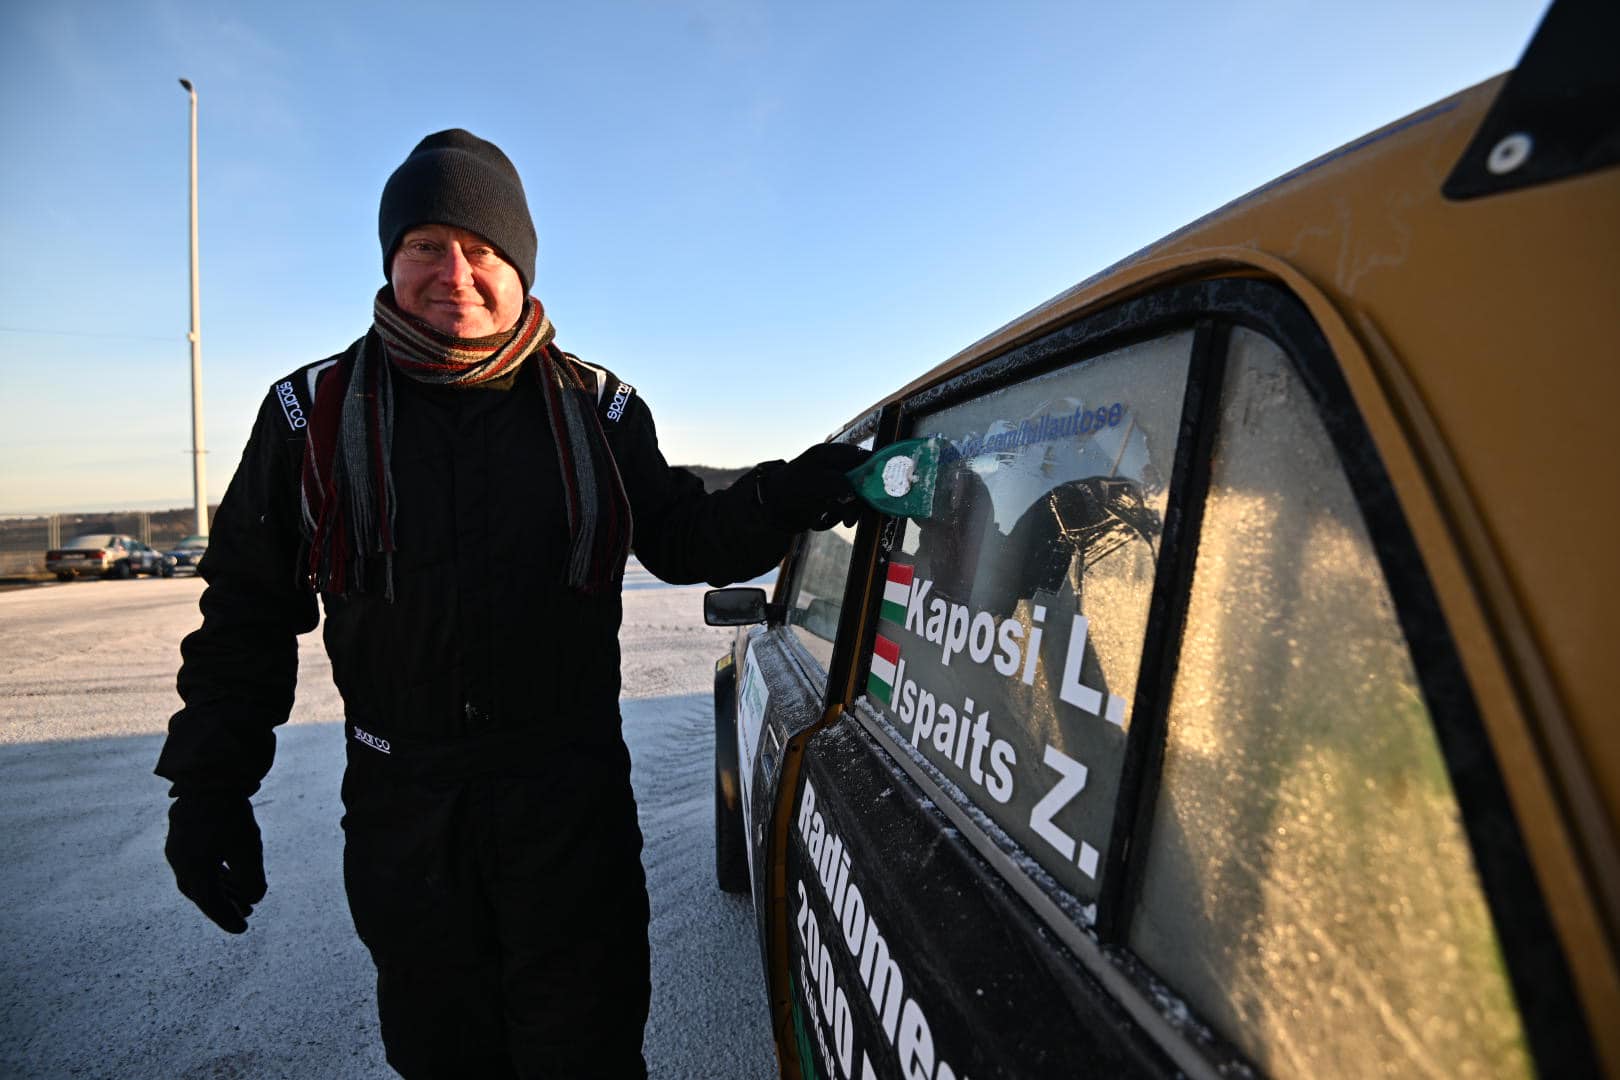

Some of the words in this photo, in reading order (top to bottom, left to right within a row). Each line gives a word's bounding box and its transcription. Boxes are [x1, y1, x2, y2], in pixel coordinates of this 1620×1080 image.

[276, 381, 307, 430] sparco
[905, 577, 1047, 686] Kaposi
[1059, 614, 1126, 726] L.
[890, 658, 1017, 804] Ispaits
[1029, 744, 1100, 880] Z.
[797, 879, 854, 1080] 2000
[798, 776, 968, 1080] Radiome
